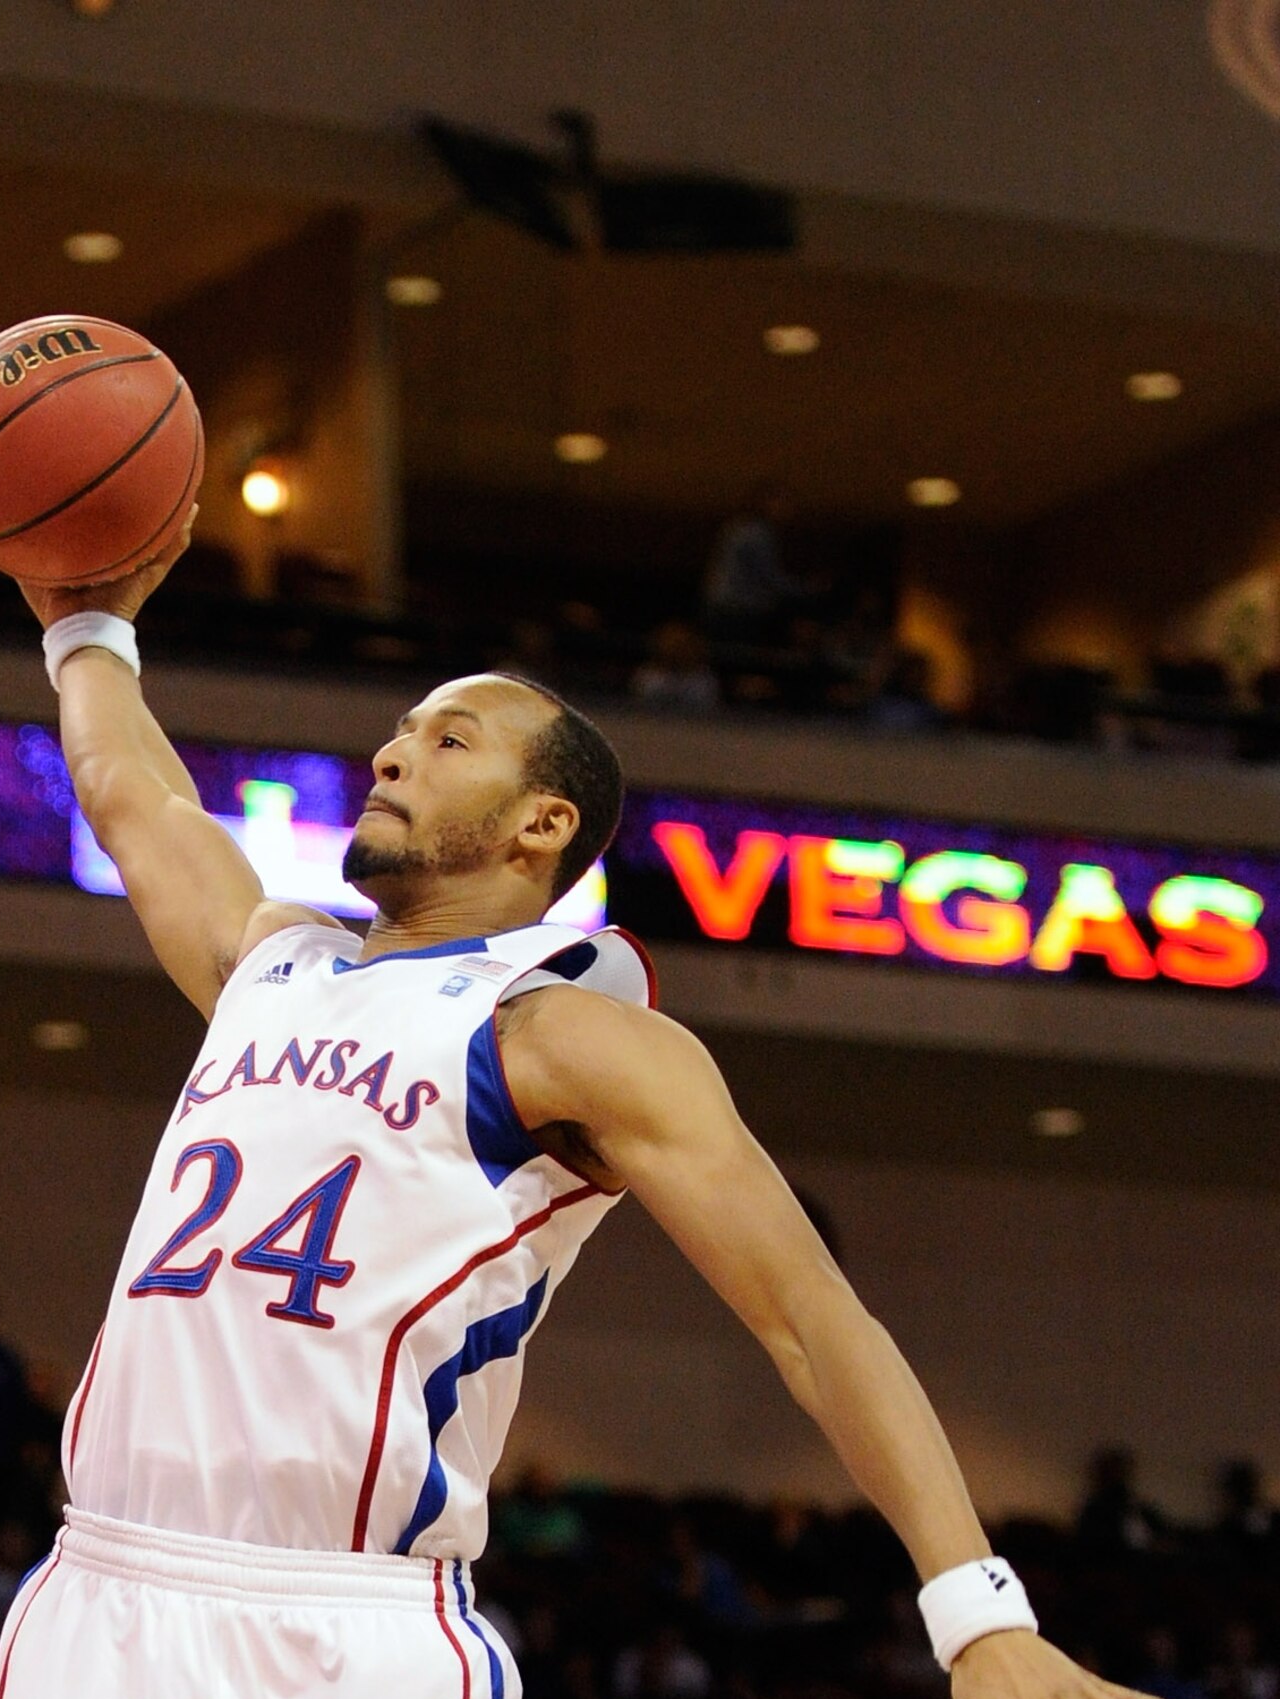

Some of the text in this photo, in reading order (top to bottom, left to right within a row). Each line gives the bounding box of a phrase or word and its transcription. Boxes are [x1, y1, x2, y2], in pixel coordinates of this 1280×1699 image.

[652, 821, 1267, 988] VEGAS
[176, 1037, 441, 1130] KANSAS
[127, 1138, 362, 1329] 24
